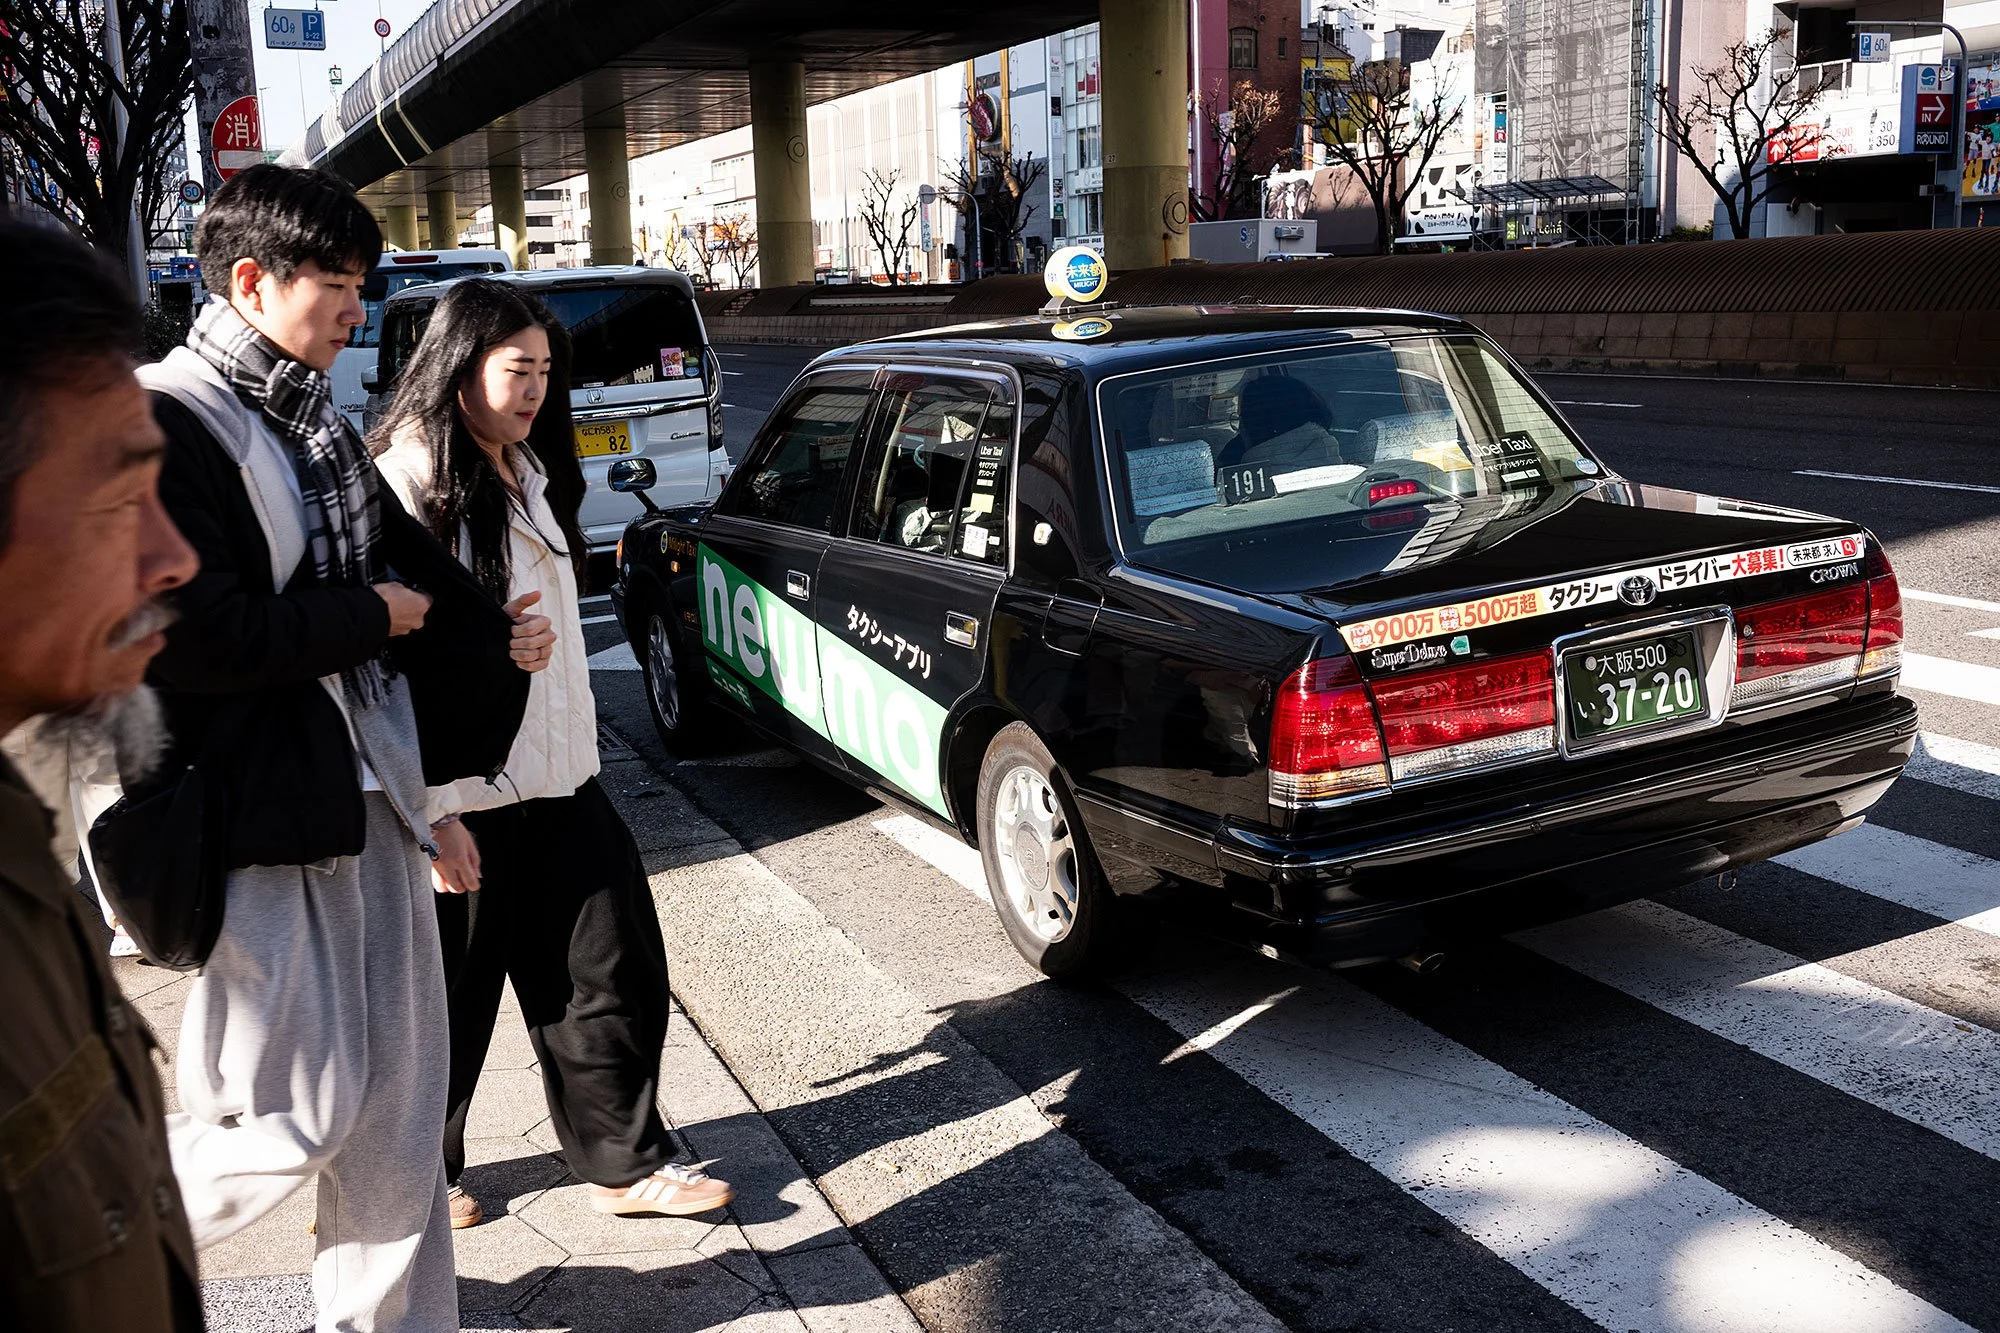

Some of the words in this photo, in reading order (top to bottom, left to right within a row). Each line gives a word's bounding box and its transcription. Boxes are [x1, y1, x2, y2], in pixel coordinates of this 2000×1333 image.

[307, 14, 318, 31] P
[377, 23, 388, 33] 60
[1863, 36, 1870, 49] P
[1921, 113, 1932, 123] IN
[1916, 131, 1949, 146] ROUND1
[184, 186, 199, 198] 50
[1066, 262, 1101, 278] 未来都
[1467, 441, 1502, 458] Uber
[1502, 435, 1533, 453] Taxi
[1231, 467, 1266, 497] 191
[1792, 545, 1821, 562] 未来都
[1822, 542, 1842, 558] 求人
[1809, 561, 1859, 584] CROWN
[1464, 592, 1537, 627] 500万超
[1350, 625, 1370, 637] TOP
[1374, 612, 1434, 644] 900万
[847, 604, 931, 679] タクシーアプリ
[703, 555, 936, 798] newmo
[1597, 667, 1695, 726] 37-20
[1577, 701, 1597, 719] い
